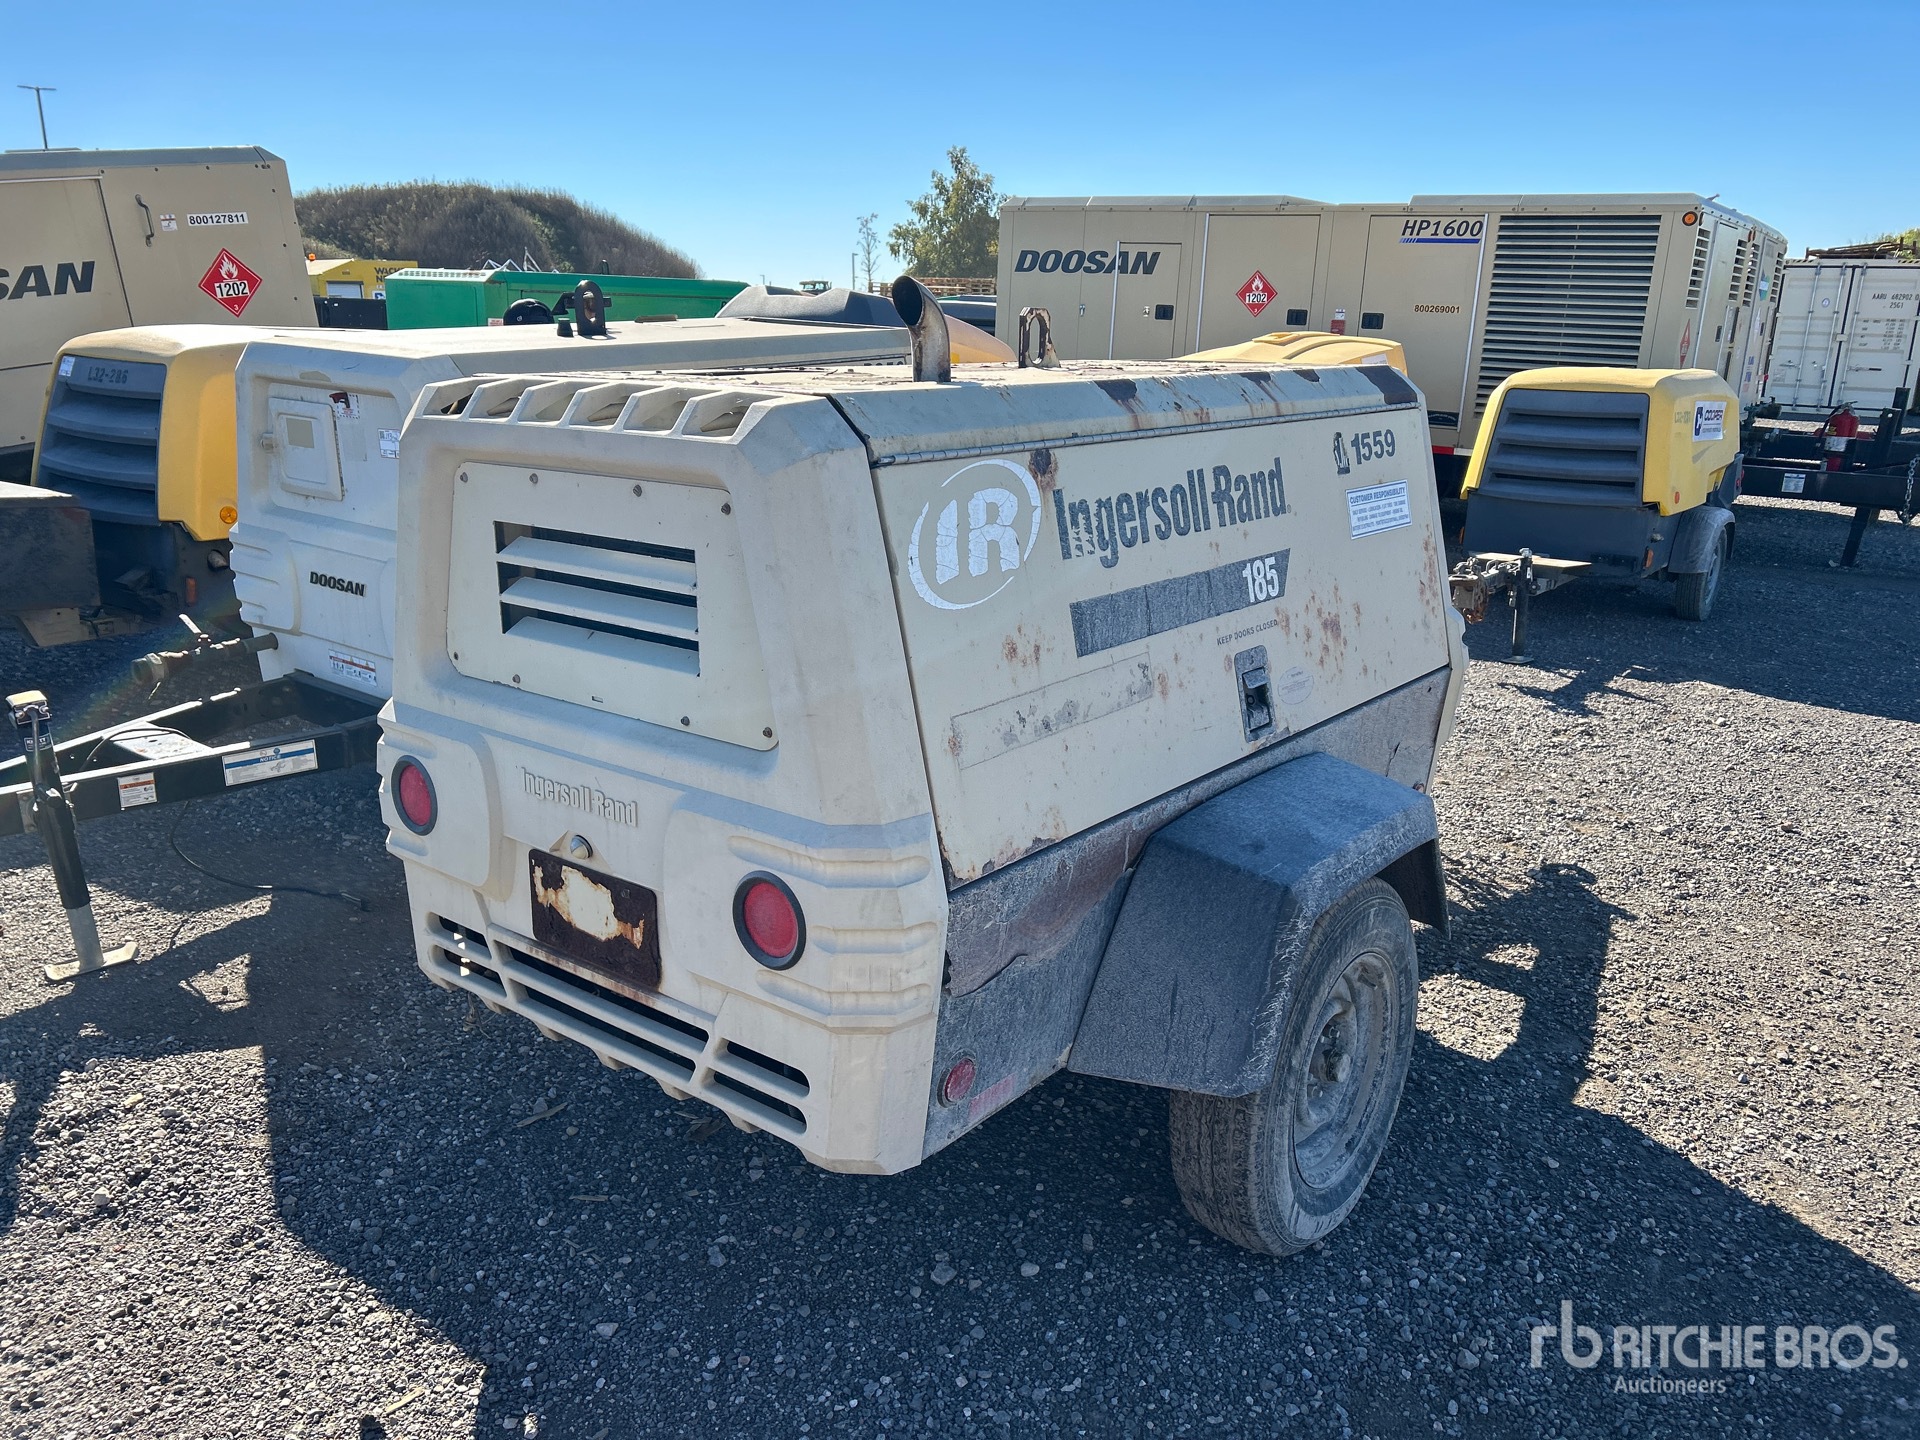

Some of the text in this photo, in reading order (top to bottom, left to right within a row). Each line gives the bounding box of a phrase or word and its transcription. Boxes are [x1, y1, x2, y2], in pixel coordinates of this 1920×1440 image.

[188, 213, 246, 225] 800127811
[1401, 219, 1484, 237] HP1600
[1014, 250, 1161, 275] DOOSAN
[0, 261, 95, 300] AN
[216, 281, 249, 298] 1202
[1246, 293, 1267, 303] 1202
[1414, 304, 1460, 314] 800269001
[1351, 429, 1396, 465] 1559
[1350, 487, 1406, 504] CUSTOMER RESPONSIBILITY
[310, 571, 365, 597] DOOSAN
[1243, 556, 1279, 603] 185
[1217, 619, 1278, 646] KEEP DOORS CLOSED
